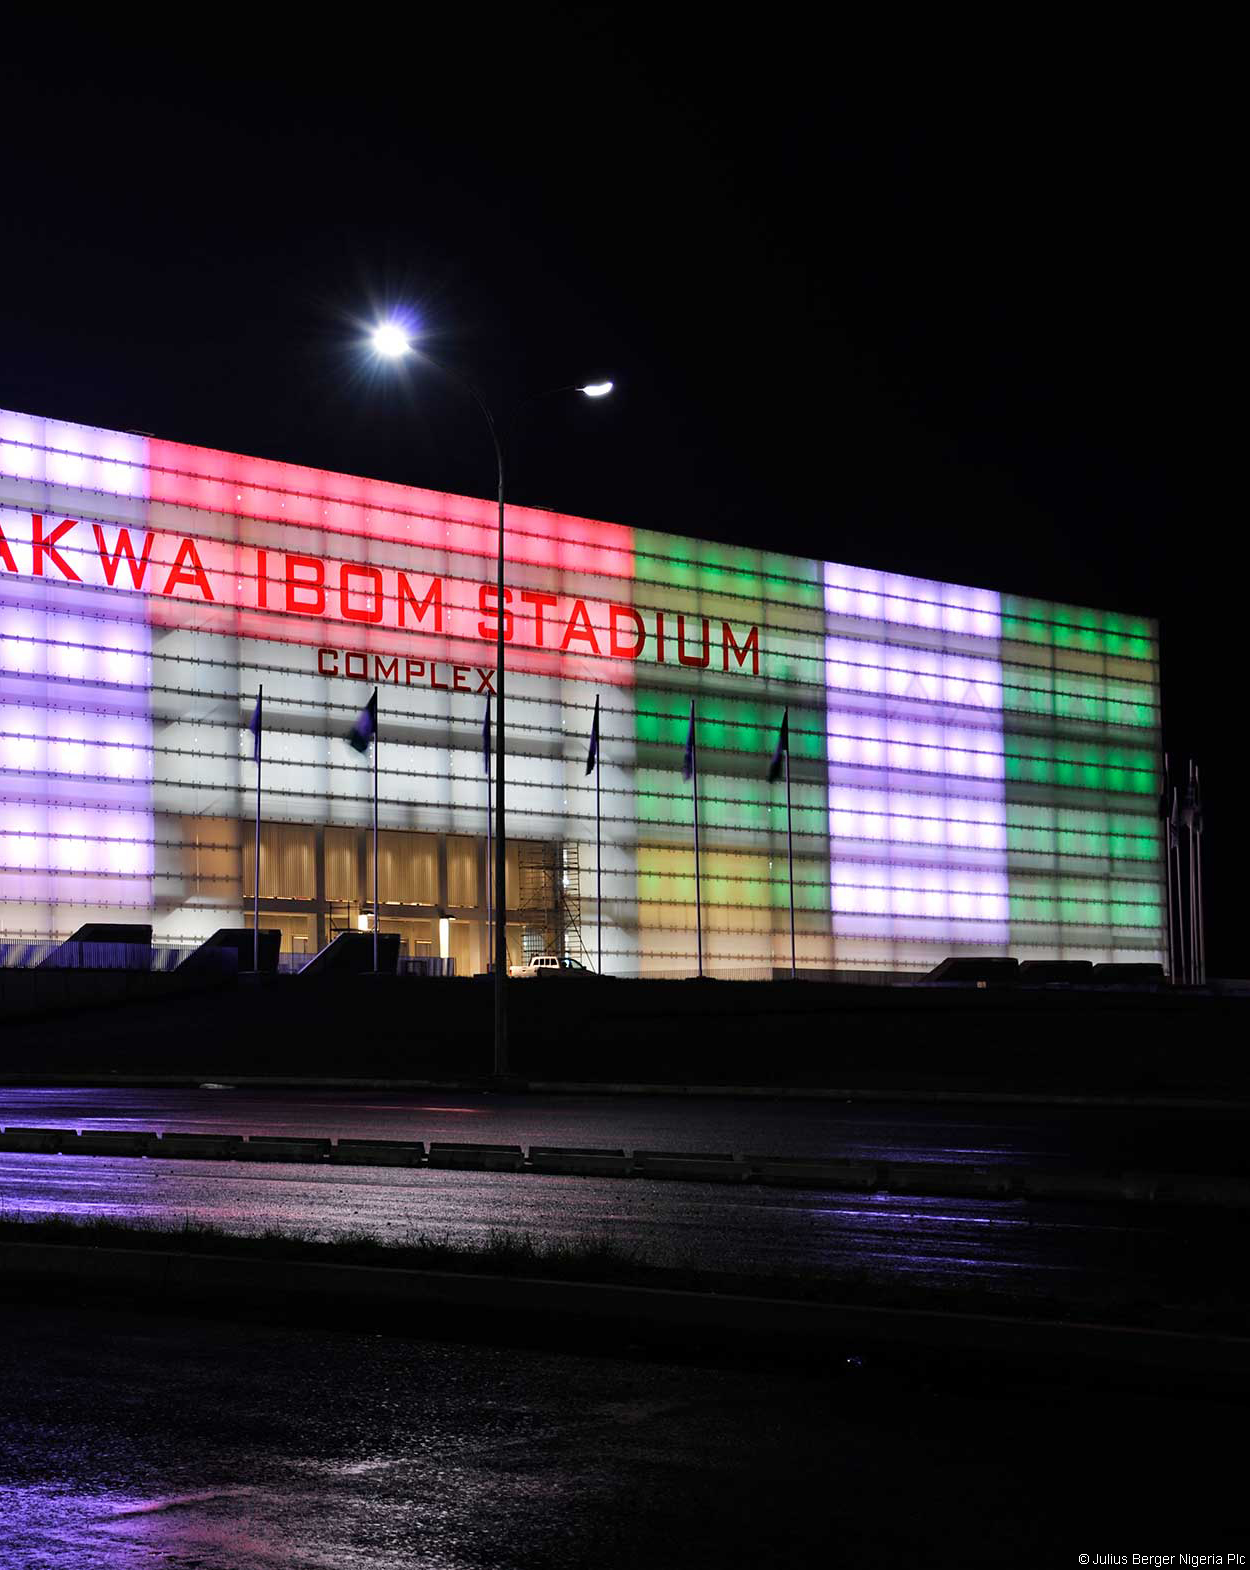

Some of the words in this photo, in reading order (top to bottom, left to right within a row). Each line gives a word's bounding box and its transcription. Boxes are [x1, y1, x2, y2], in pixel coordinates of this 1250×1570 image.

[257, 550, 443, 633] IBOM
[477, 584, 760, 676] STADIUM
[317, 648, 498, 695] COMPLEX
